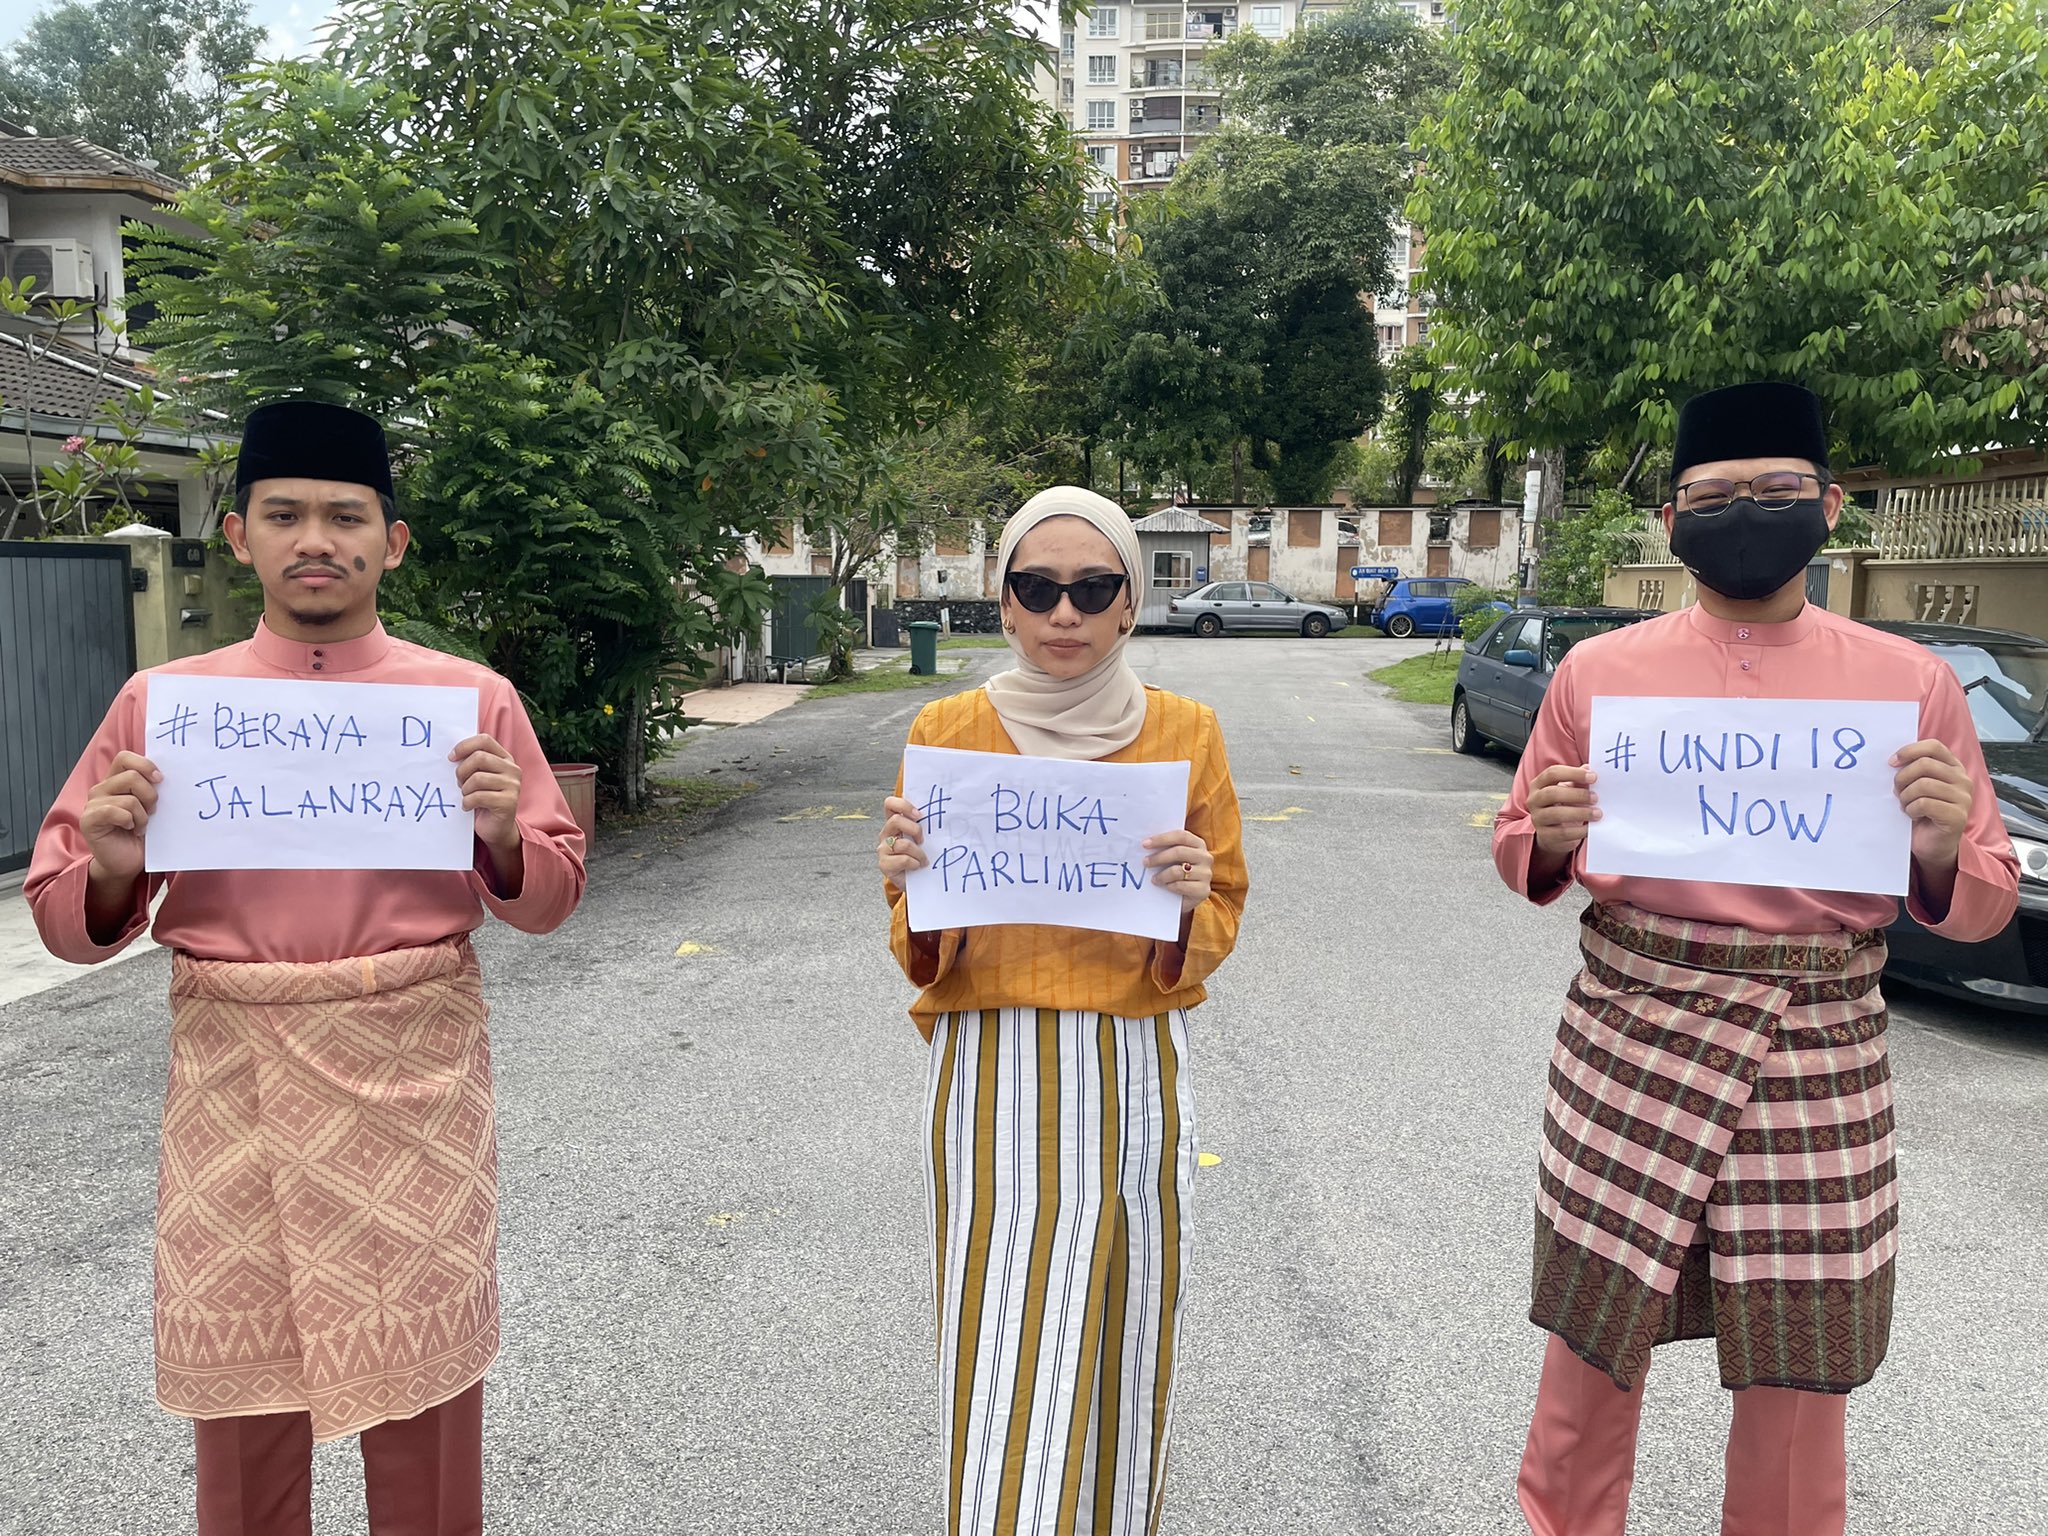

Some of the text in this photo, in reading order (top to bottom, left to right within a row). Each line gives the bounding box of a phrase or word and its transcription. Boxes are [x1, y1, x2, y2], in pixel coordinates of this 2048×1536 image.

[213, 702, 368, 754] BERAYA
[400, 715, 432, 749] DI
[1659, 730, 1781, 775] UNDI
[1811, 727, 1866, 770] 18
[195, 774, 456, 823] JALANRAYA
[990, 782, 1119, 836] BUKA
[1698, 784, 1833, 844] NOW
[932, 844, 1147, 893] PARLIMEN
